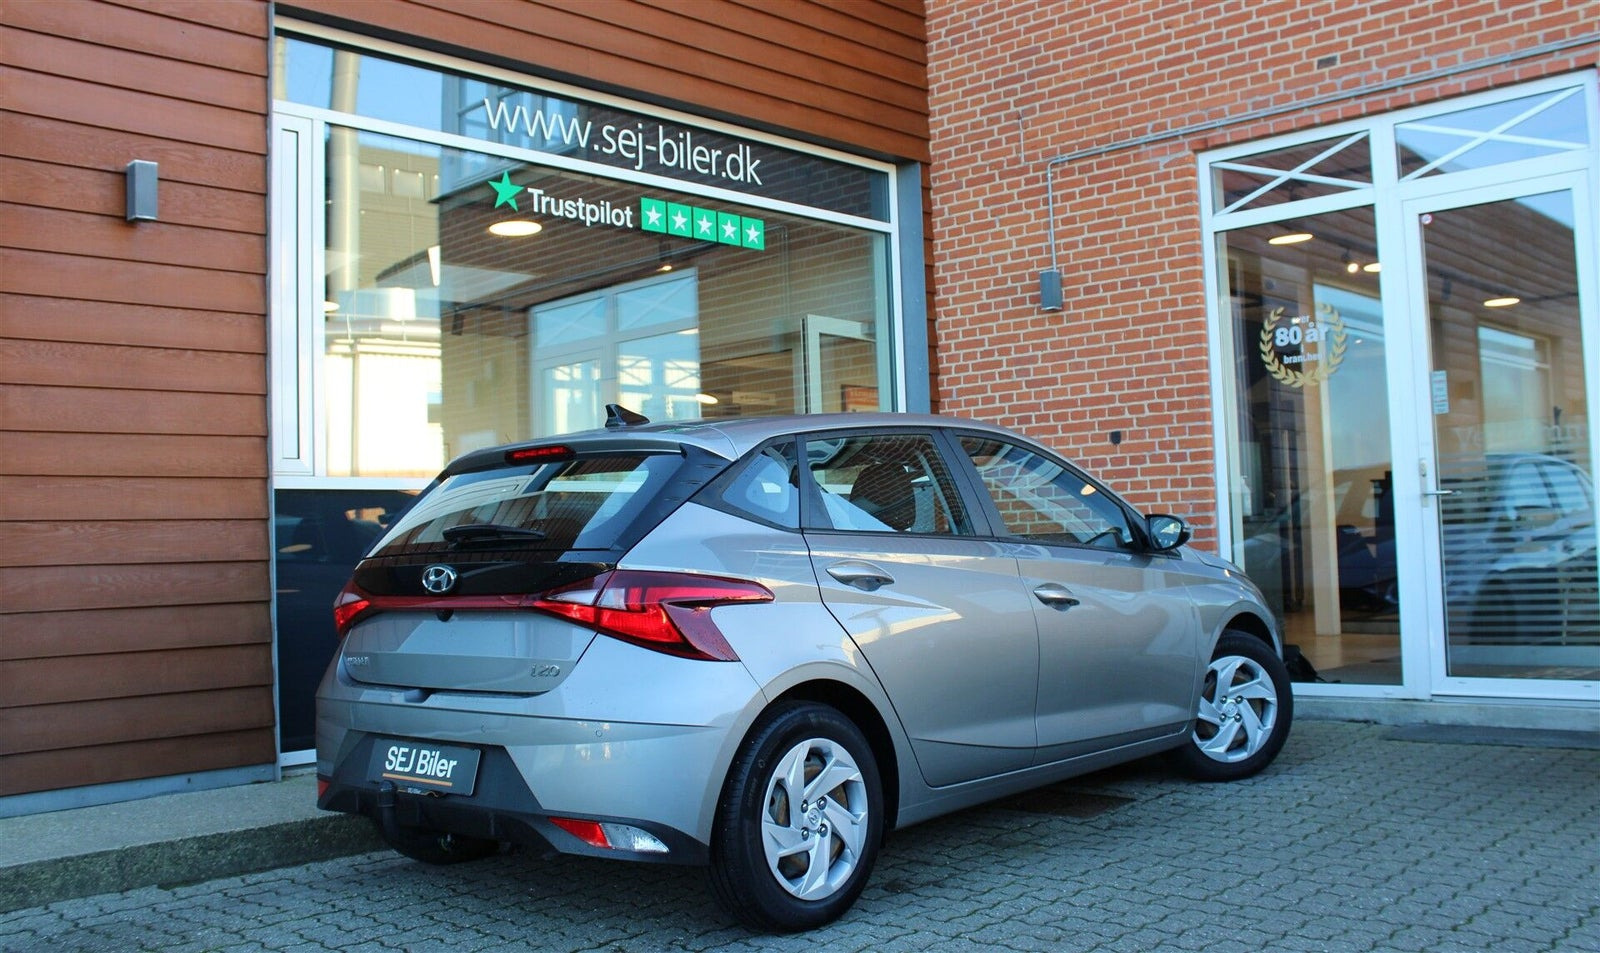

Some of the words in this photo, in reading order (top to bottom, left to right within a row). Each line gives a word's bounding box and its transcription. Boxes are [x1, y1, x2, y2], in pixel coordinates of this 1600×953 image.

[484, 98, 763, 186] www.sej-biler.dk
[527, 187, 633, 228] Trustpilot
[1275, 326, 1303, 347] 80
[1305, 321, 1328, 343] år
[385, 746, 417, 772] SEJ
[415, 749, 458, 778] Biler
